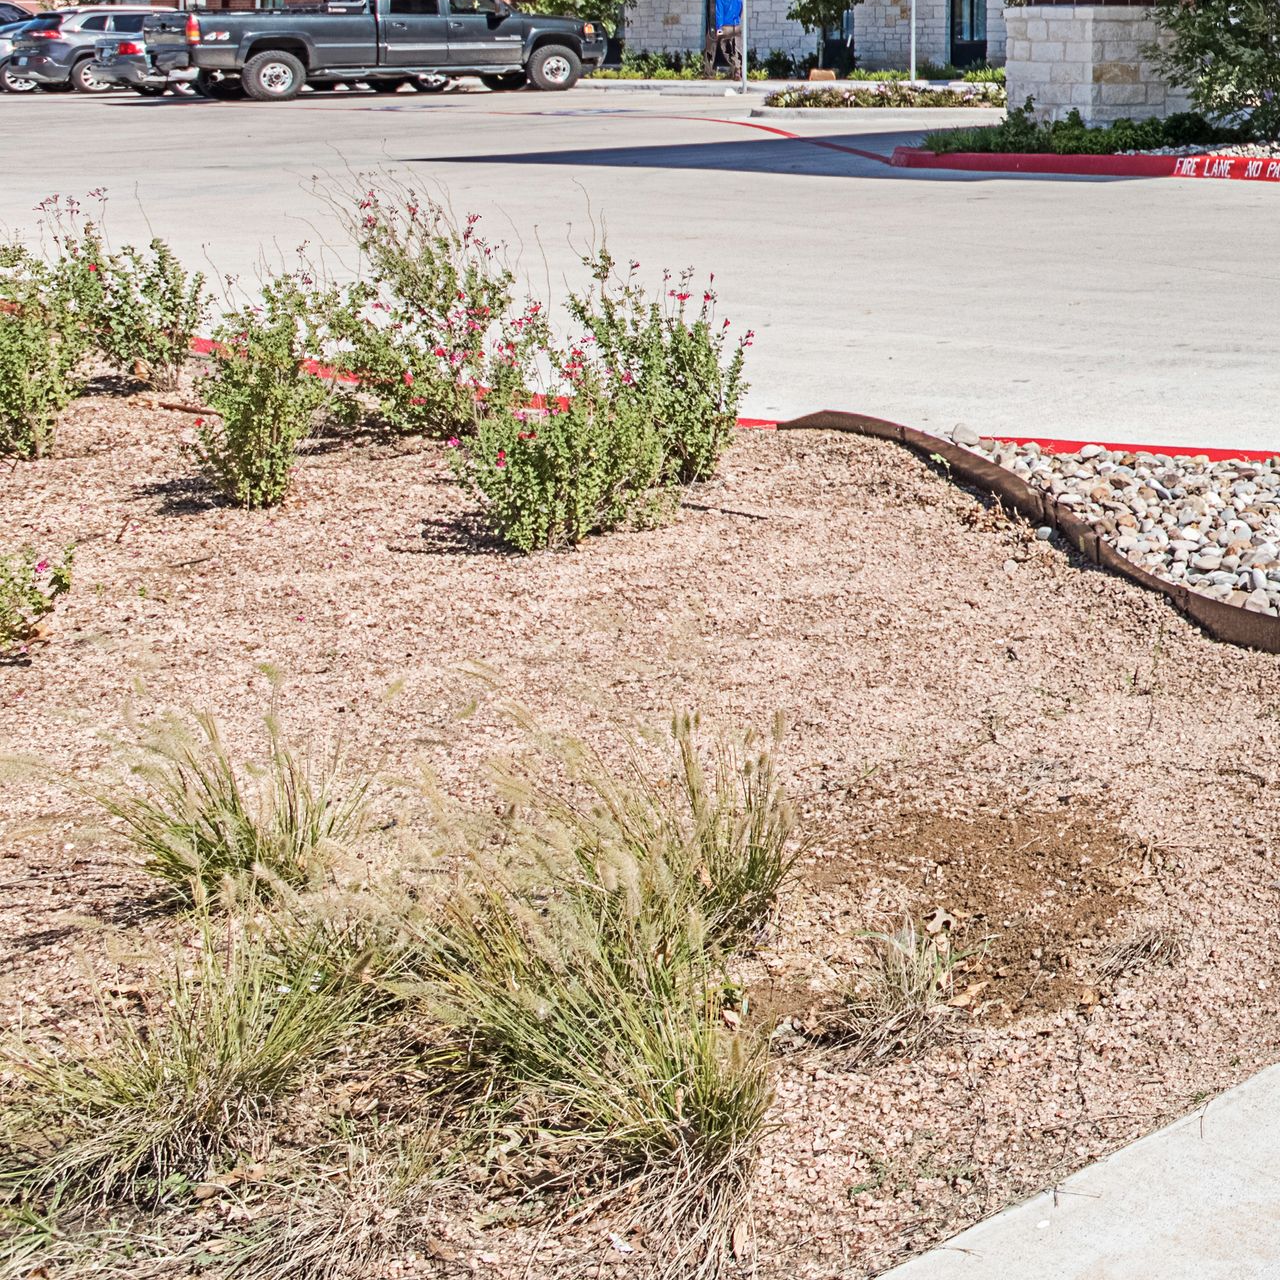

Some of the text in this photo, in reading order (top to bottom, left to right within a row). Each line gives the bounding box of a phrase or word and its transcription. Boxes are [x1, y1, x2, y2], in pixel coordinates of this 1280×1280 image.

[1173, 158, 1200, 176] FIRE
[1203, 159, 1235, 178] LANE
[1245, 160, 1263, 178] NO
